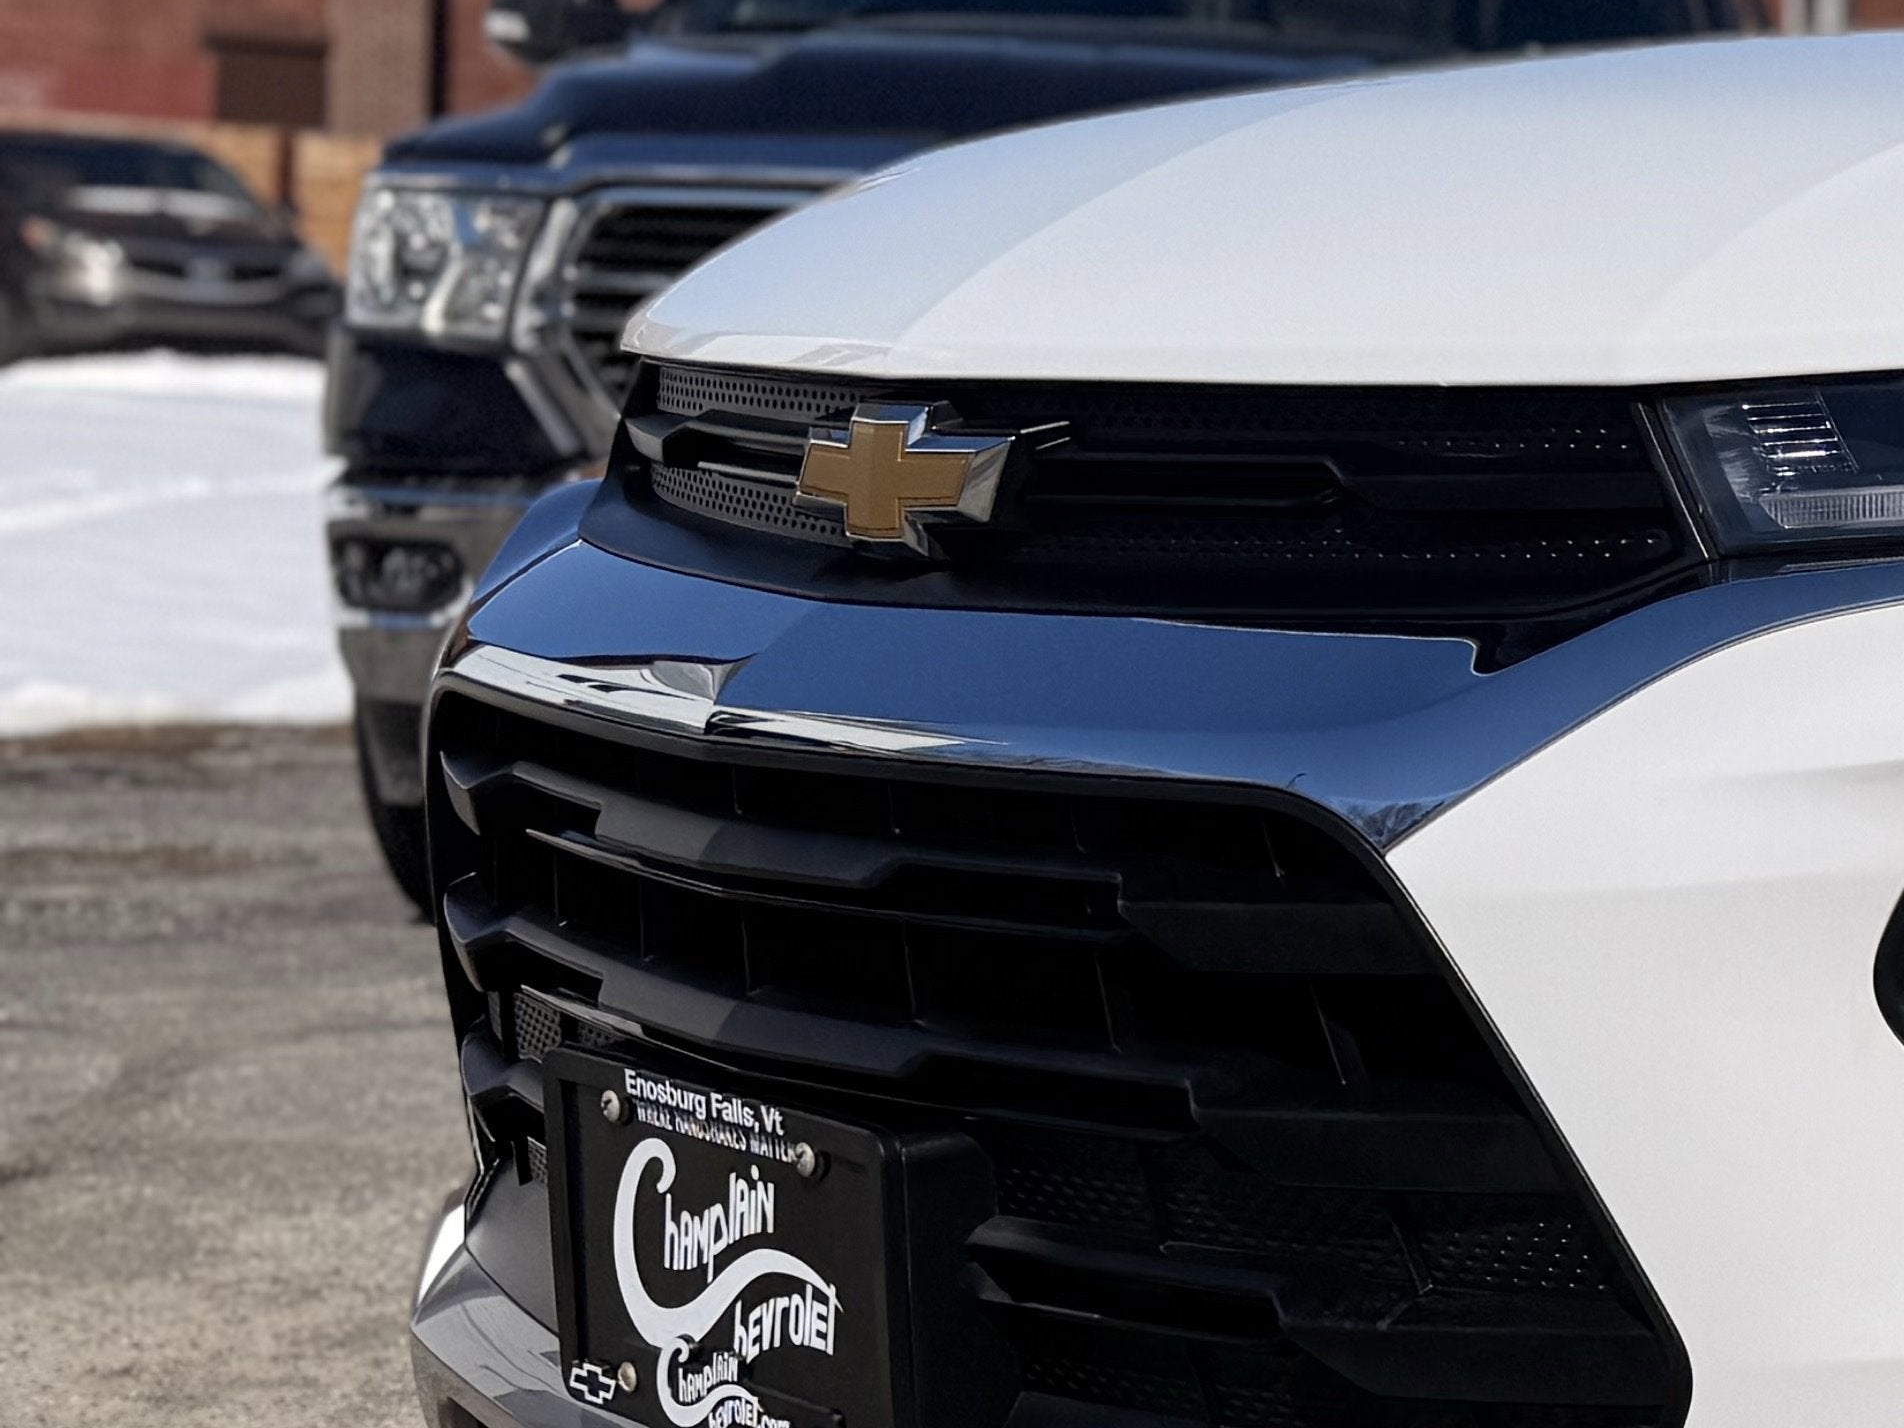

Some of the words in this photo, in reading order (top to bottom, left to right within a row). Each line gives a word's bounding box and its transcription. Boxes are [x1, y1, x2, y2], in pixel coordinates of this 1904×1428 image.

[624, 1068, 706, 1120] Enosburg
[710, 1092, 759, 1133] Falls,
[760, 1105, 785, 1136] Vt
